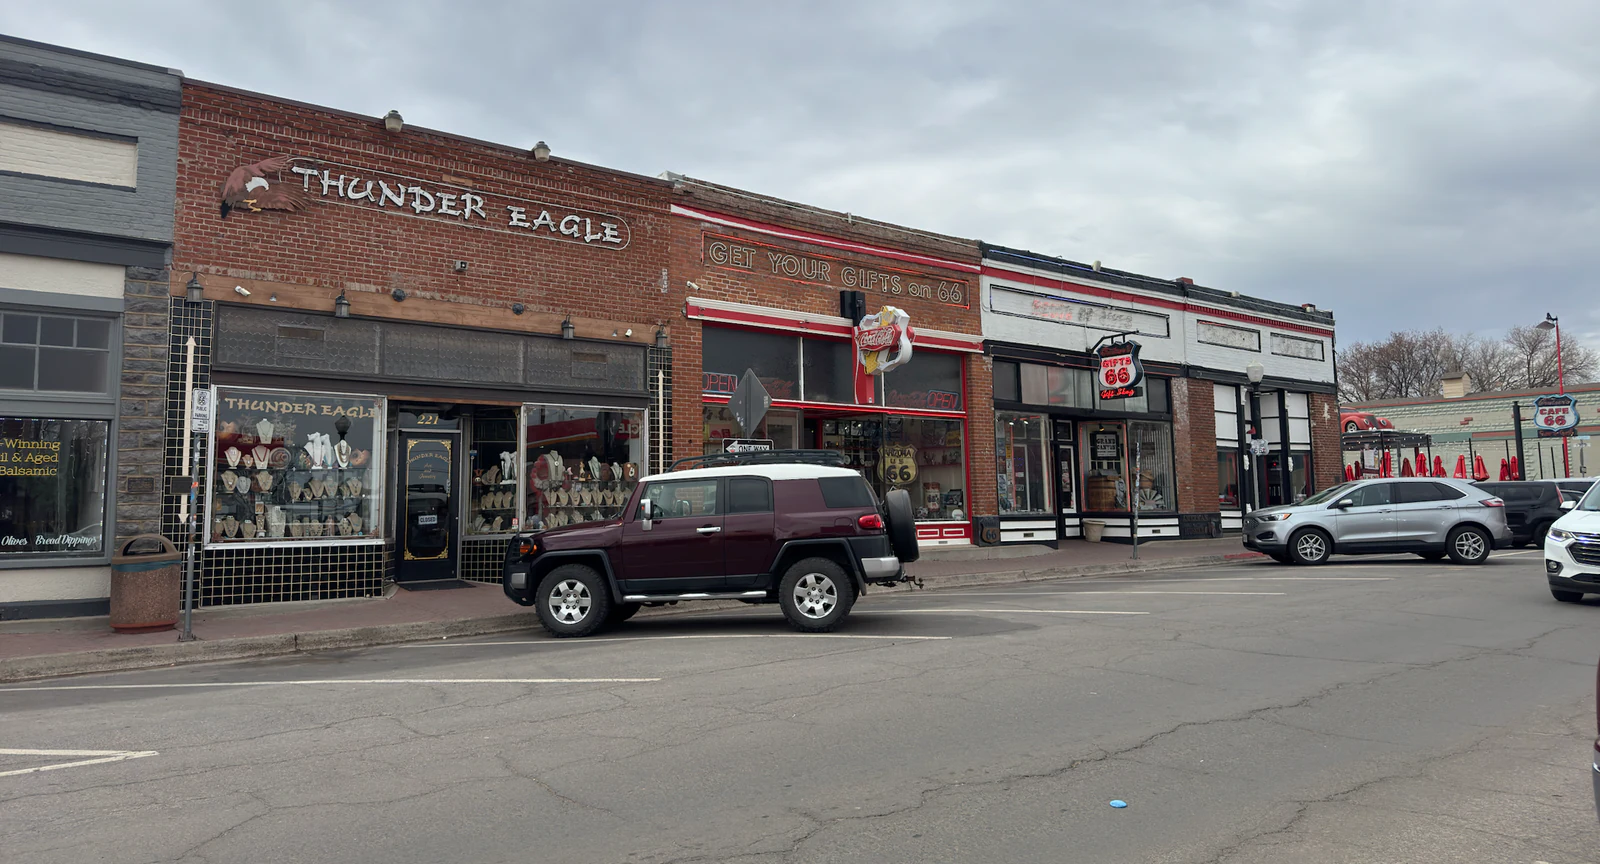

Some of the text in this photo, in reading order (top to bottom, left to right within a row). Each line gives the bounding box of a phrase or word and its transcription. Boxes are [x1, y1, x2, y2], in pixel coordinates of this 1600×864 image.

[291, 166, 622, 243] THUNDER EAGLE
[709, 241, 962, 303] GET YOUR GIFTS on 66
[1102, 356, 1132, 368] GIFTS
[1104, 367, 1130, 386] 66
[702, 374, 737, 392] OPEN
[928, 392, 958, 409] OPEN
[225, 397, 317, 415] THUNDER
[321, 404, 378, 418] EAGLE
[1540, 407, 1569, 415] CAFE
[417, 414, 439, 425] 221
[1544, 415, 1567, 426] 66
[12, 453, 21, 462] &
[25, 453, 59, 465] Aged
[0, 466, 57, 476] Balsamic
[886, 465, 911, 481] 66
[1, 535, 28, 546] Olives
[986, 530, 997, 539] 66
[35, 535, 97, 547] Bread Dippings
